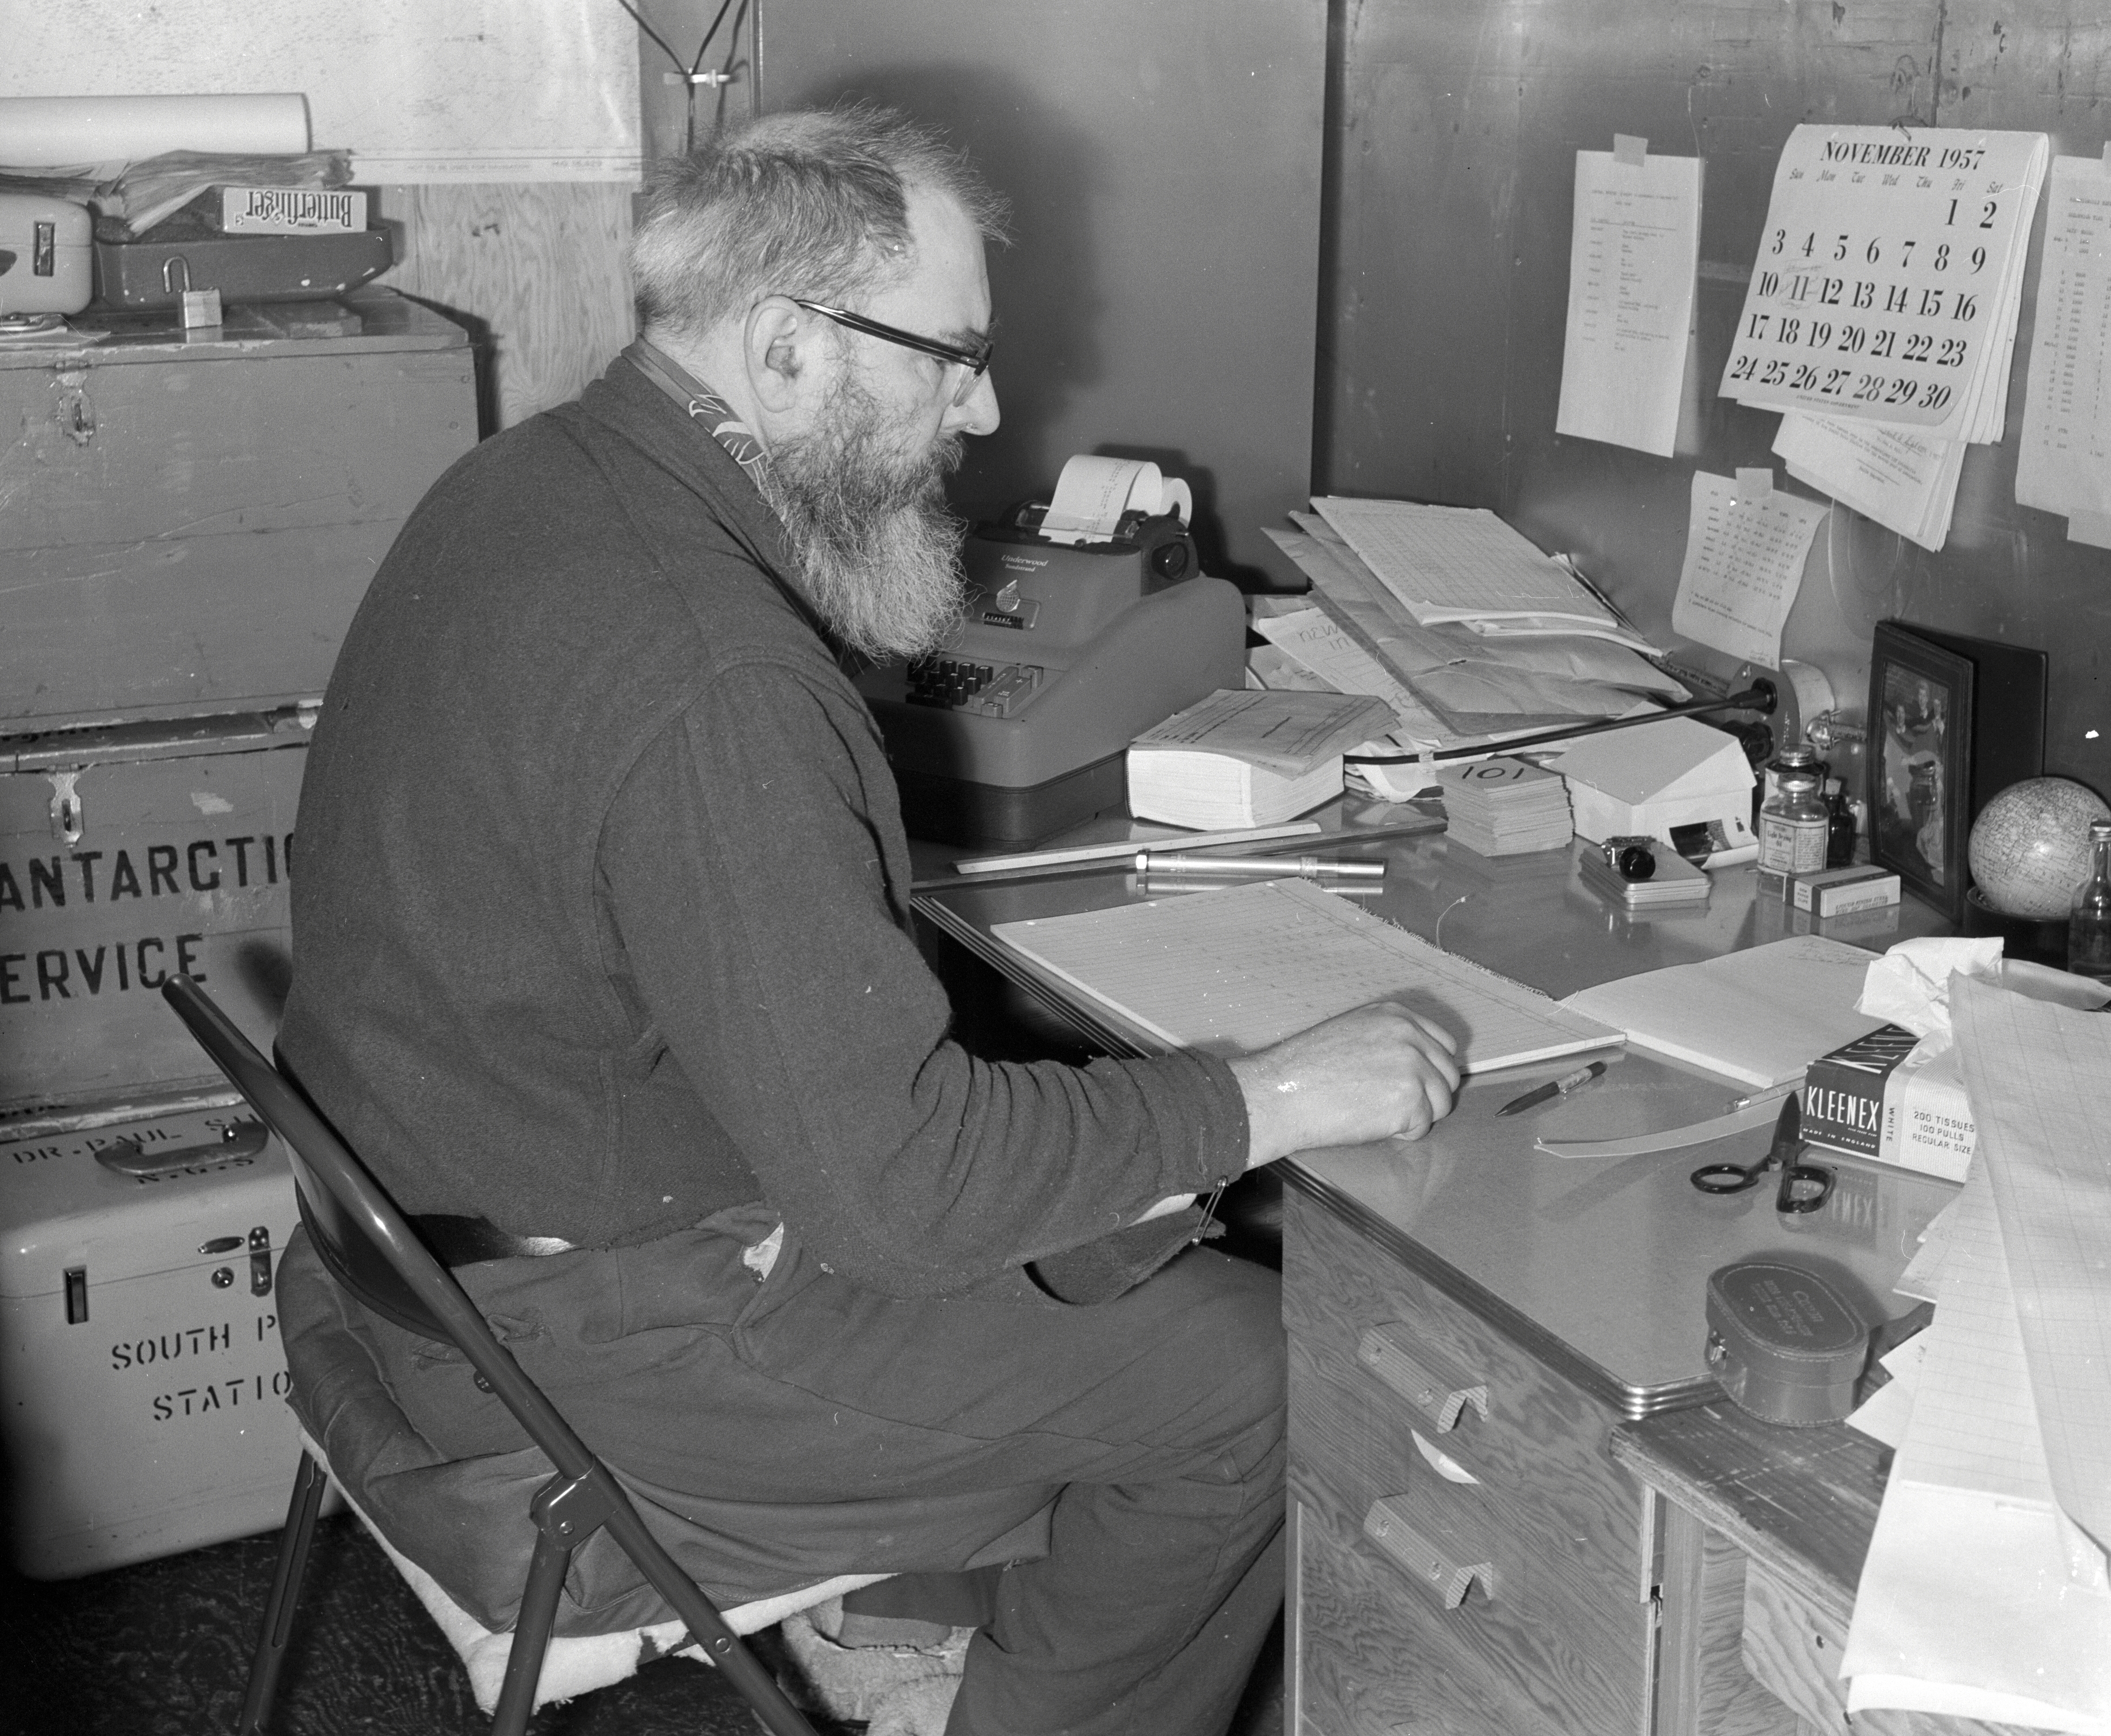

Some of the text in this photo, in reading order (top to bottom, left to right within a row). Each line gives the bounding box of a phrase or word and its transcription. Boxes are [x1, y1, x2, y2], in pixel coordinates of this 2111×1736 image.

[1821, 140, 1986, 171] NOVEMBER 1957
[1789, 167, 1805, 181] Sun
[1816, 169, 1836, 183] Mon
[1881, 173, 1900, 187] Wed
[1916, 176, 1933, 189] Thu
[1952, 177, 1966, 192] Fri
[1986, 181, 2004, 194] Sat
[246, 190, 352, 228] Butterfinger
[1945, 198, 1998, 229] 1 2
[1772, 228, 1986, 275] 3 4 5 6 7 8 9
[1756, 271, 1977, 322] 10 11 12 13 14 15 16
[1745, 313, 1967, 367] 17 18 19 20 21 22 23
[1730, 355, 1952, 410] 24 25 26 27 28 29 30
[1001, 555, 1048, 566] Underwood
[1005, 563, 1035, 572] Sundstrand
[1462, 765, 1525, 781] 101
[0, 832, 294, 912] ANTARCTI
[0, 933, 207, 1004] ERVICE
[1806, 1085, 1879, 1132] KLEENEX
[1886, 1107, 1895, 1142] WHITE
[1914, 1111, 1975, 1133] 200 TISSUES
[1803, 1128, 1823, 1136] MADE
[1841, 1136, 1876, 1149] ENGLAND
[1912, 1133, 1972, 1155] REGULAR SIZE
[1919, 1123, 1964, 1142] 100 PULLS
[112, 1323, 230, 1371] SOUTH
[153, 1370, 291, 1422] STATIO
